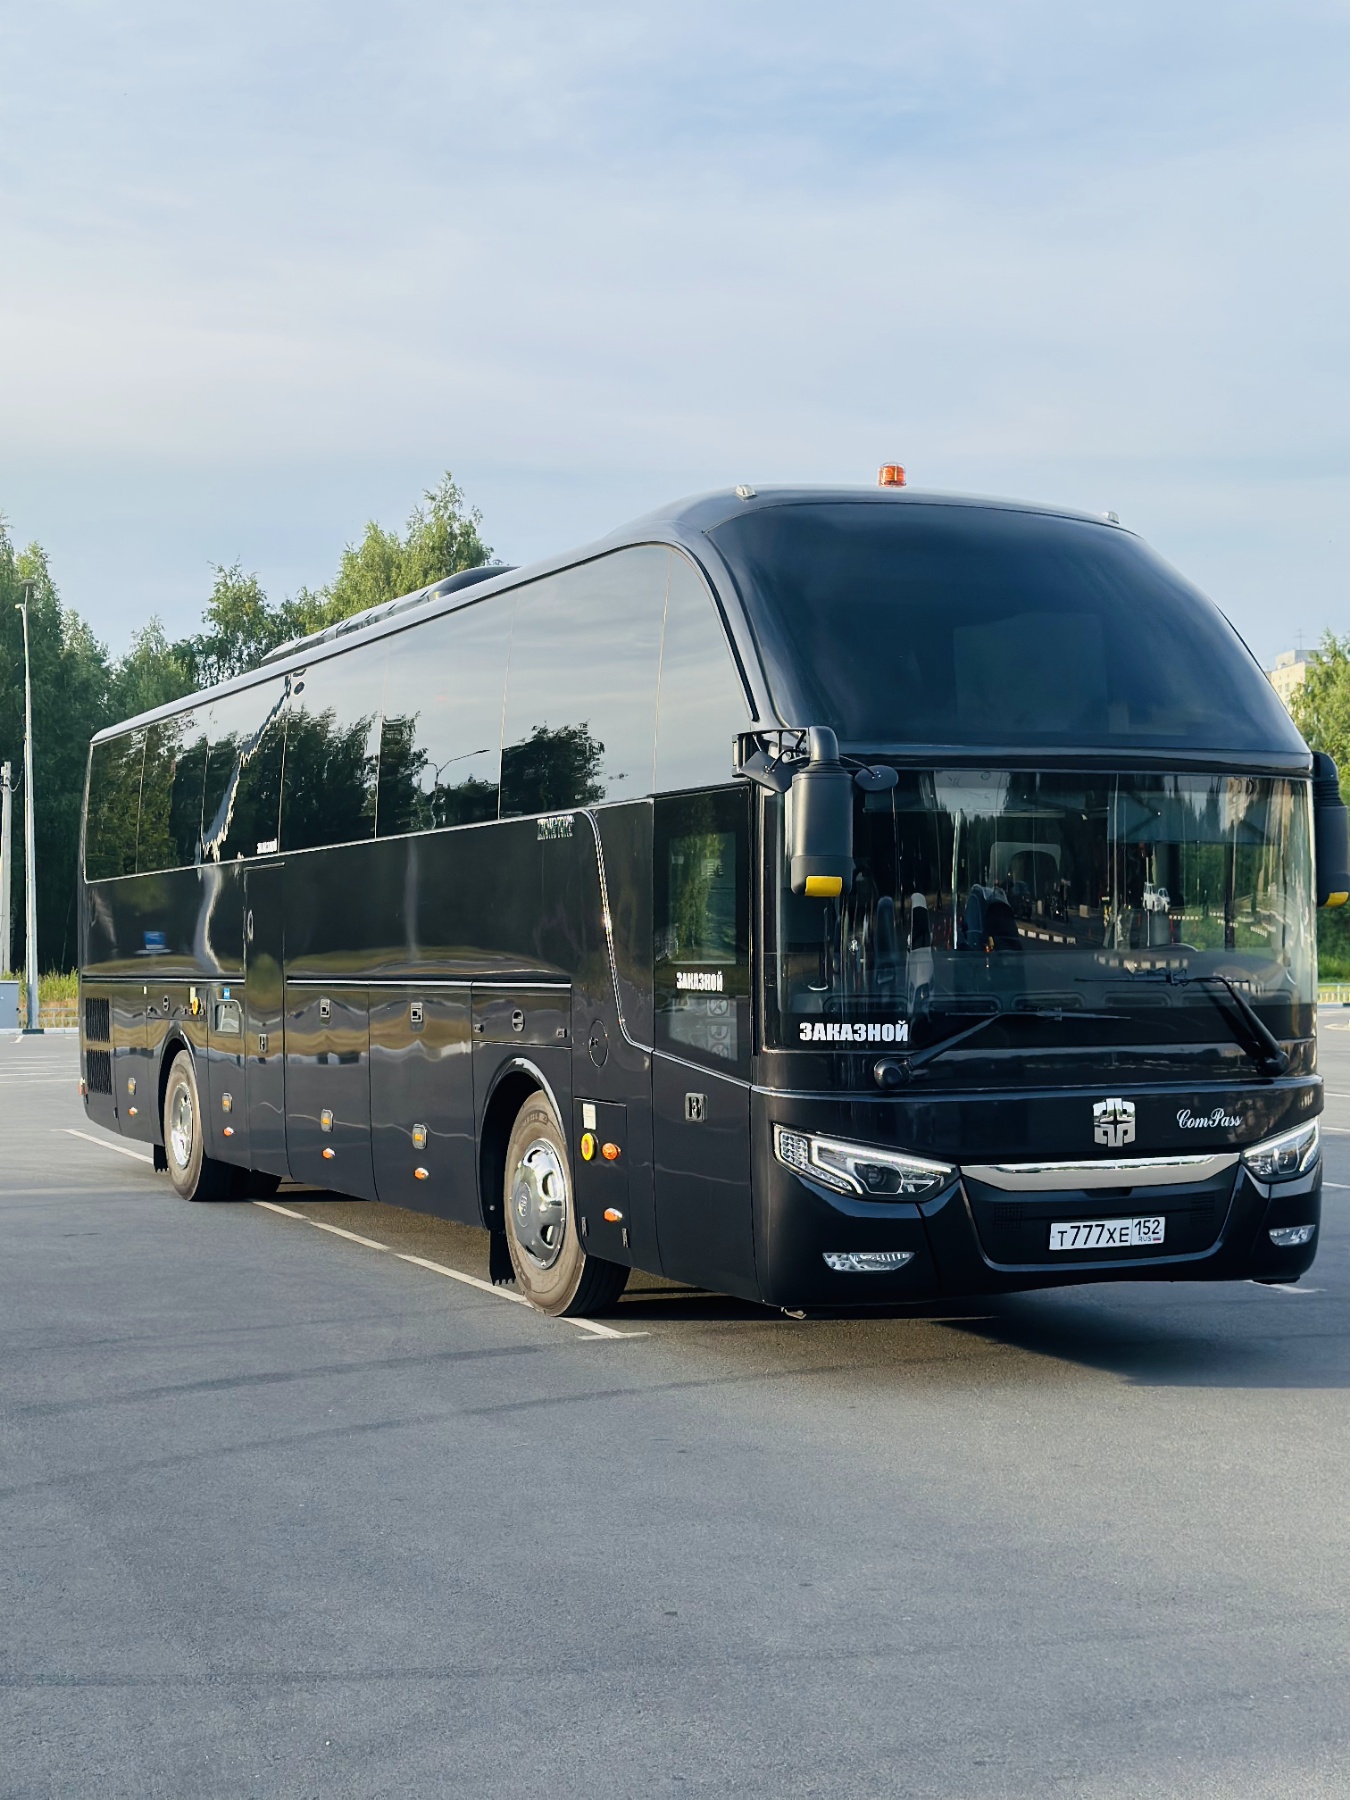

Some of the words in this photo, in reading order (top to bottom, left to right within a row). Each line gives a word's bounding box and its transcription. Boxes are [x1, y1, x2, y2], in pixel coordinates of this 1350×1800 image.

[676, 971, 723, 992] ЗАКАЗНОЙ
[799, 1020, 909, 1042] ЗАКАЗНОЙ
[1134, 1219, 1161, 1236] 152
